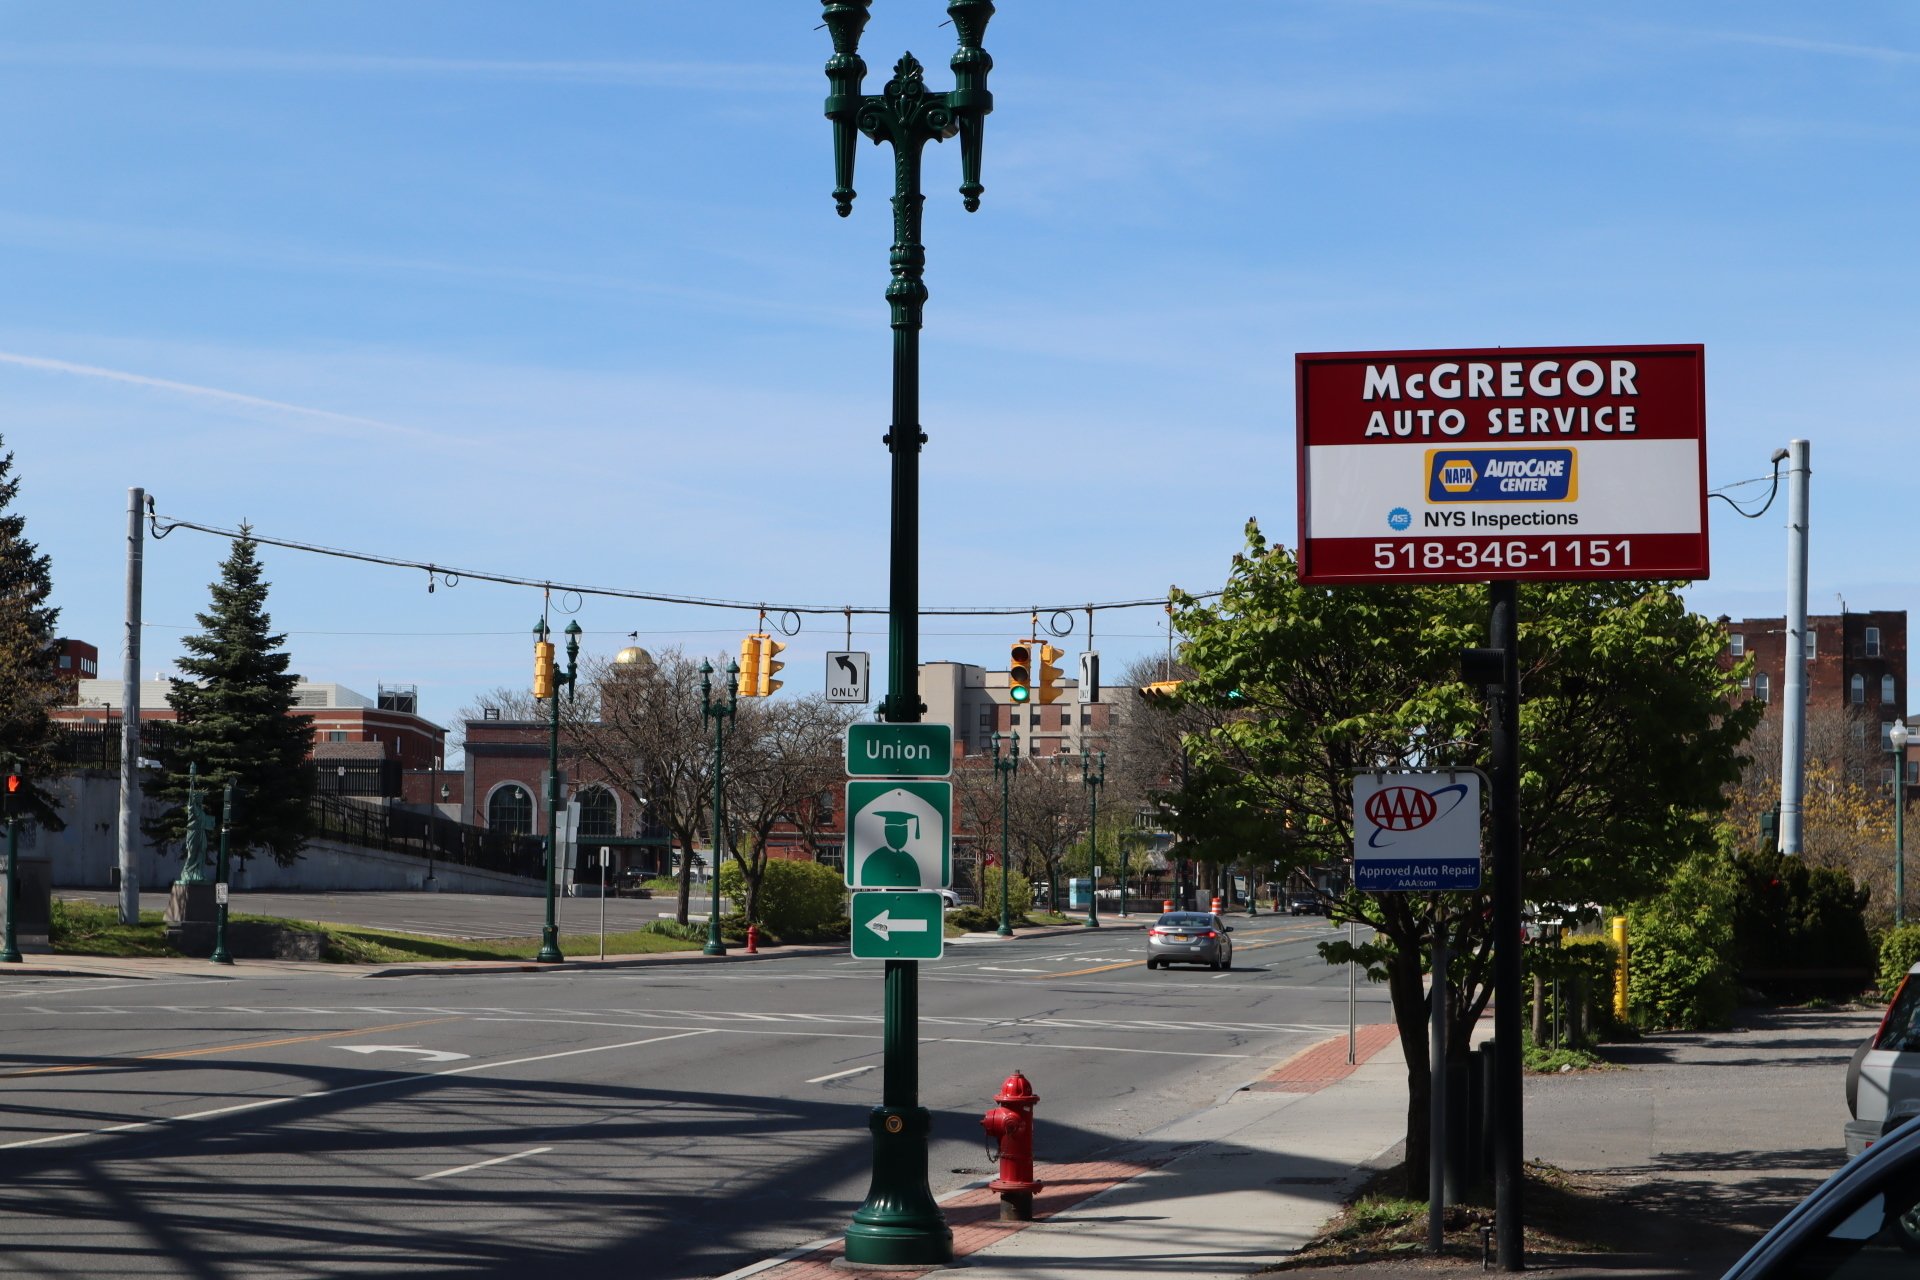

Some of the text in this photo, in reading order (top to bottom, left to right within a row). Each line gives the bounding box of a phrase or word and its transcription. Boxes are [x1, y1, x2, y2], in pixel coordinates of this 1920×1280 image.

[1363, 359, 1639, 400] McGREGOR
[1365, 405, 1637, 436] AUTO SERVICE
[1445, 468, 1473, 484] NAPA
[1500, 478, 1548, 492] CENTER
[1391, 514, 1409, 523] ASE
[1424, 510, 1579, 530] NYS Inspections
[1373, 540, 1632, 569] 518-346-1151
[831, 687, 860, 697] ONLY
[866, 739, 930, 760] Union
[1370, 786, 1433, 831] AAA
[1359, 865, 1476, 878] Approved Auto Repair
